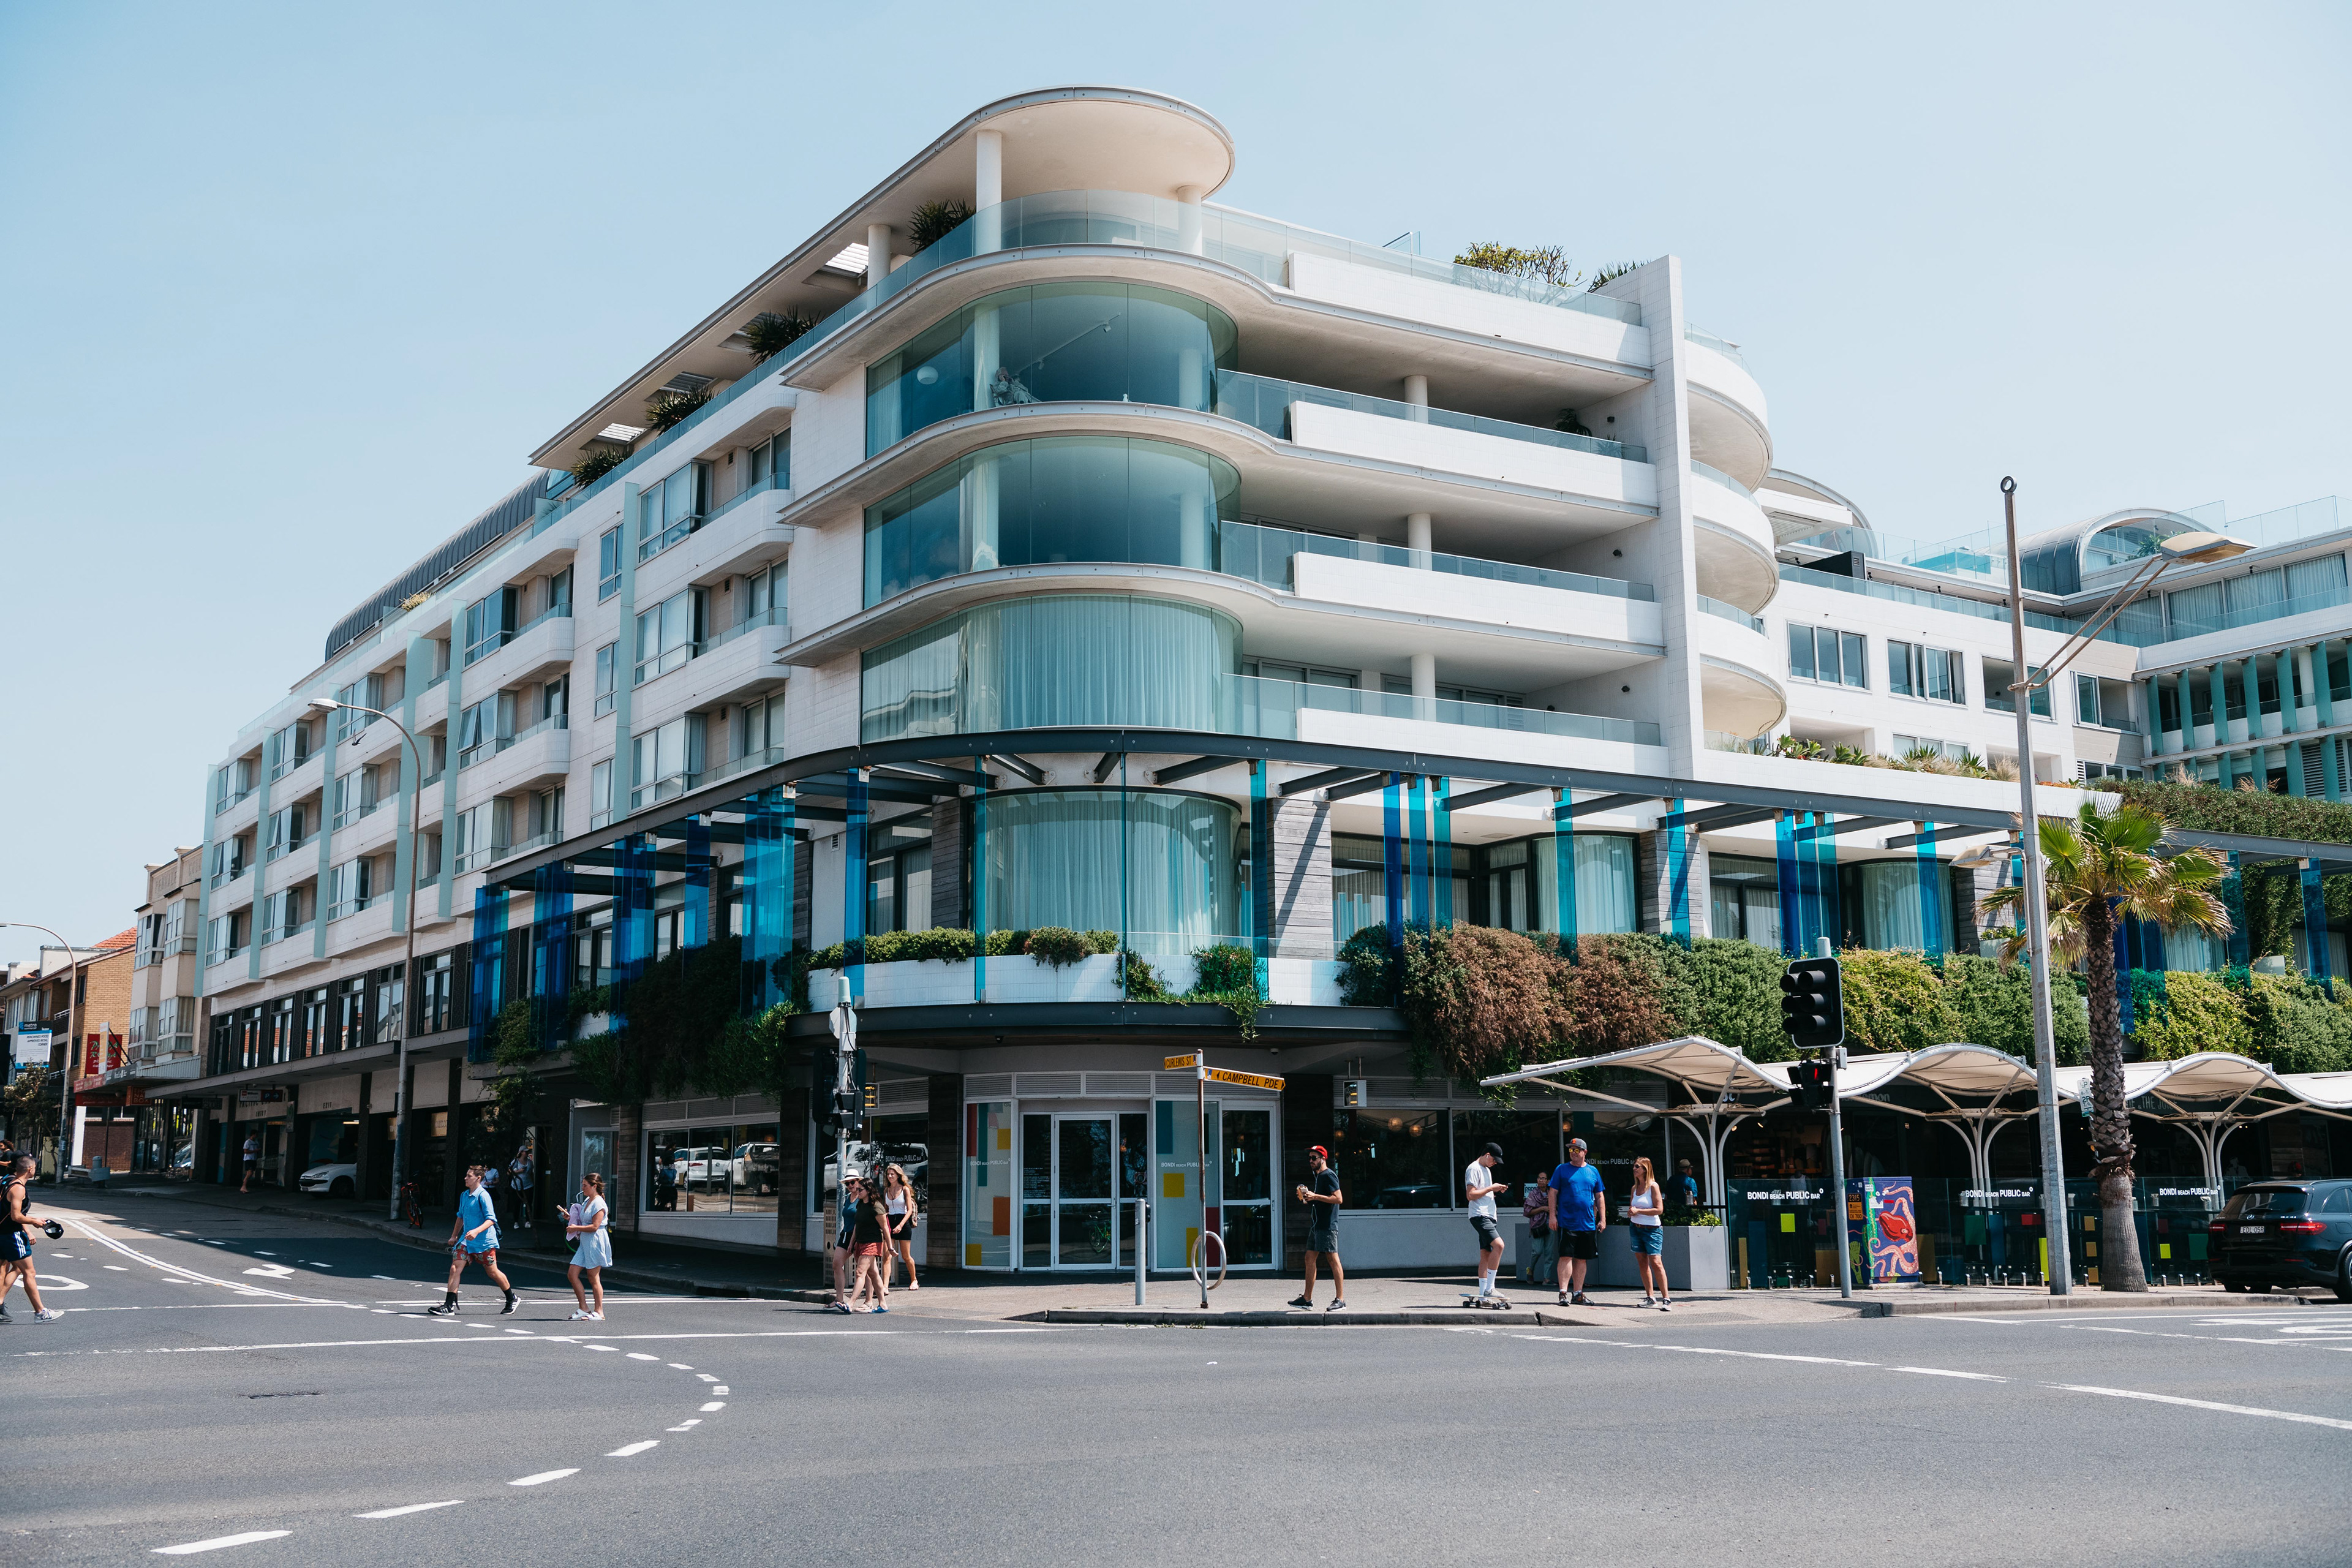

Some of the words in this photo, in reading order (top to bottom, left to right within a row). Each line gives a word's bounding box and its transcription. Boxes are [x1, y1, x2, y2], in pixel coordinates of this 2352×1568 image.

[1166, 1057, 1185, 1068] CURLEWIS
[1186, 1056, 1192, 1066] ST
[1223, 1072, 1260, 1087] CAMPBELL
[1264, 1078, 1279, 1090] PDE
[2141, 1096, 2155, 1110] THE
[1747, 1191, 1769, 1200] BONDI
